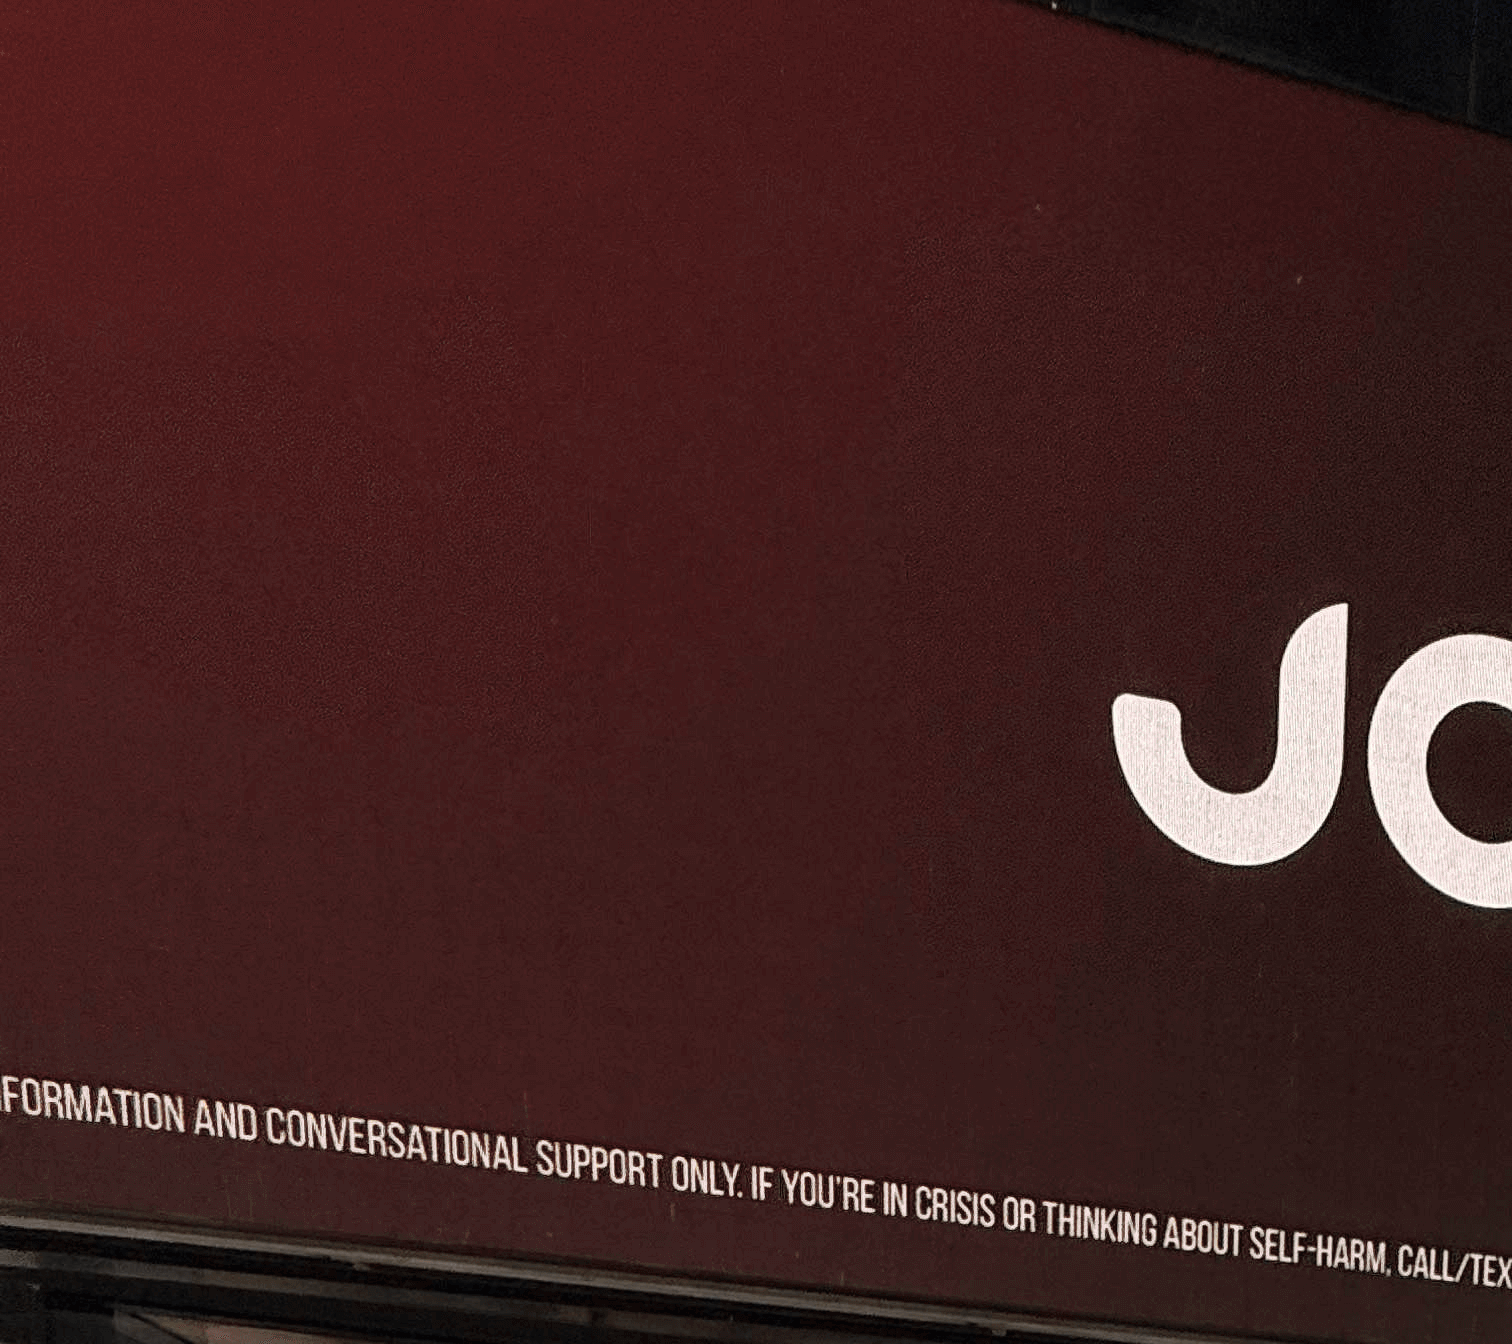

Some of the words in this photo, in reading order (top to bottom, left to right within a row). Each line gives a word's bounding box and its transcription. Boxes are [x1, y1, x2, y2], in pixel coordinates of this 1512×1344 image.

[194, 1099, 257, 1142] AND
[265, 1107, 529, 1173] CONVERSATIONAL
[536, 1139, 664, 1189] SUPPORT
[672, 1155, 743, 1198] ONLY.
[751, 1165, 775, 1201] IF
[781, 1168, 876, 1214] YOU'RE
[883, 1181, 908, 1218] IN
[916, 1185, 996, 1228] CRISIS
[1003, 1195, 1036, 1233] OR
[1042, 1200, 1158, 1247] THINKING
[1163, 1216, 1244, 1257] ABOUT
